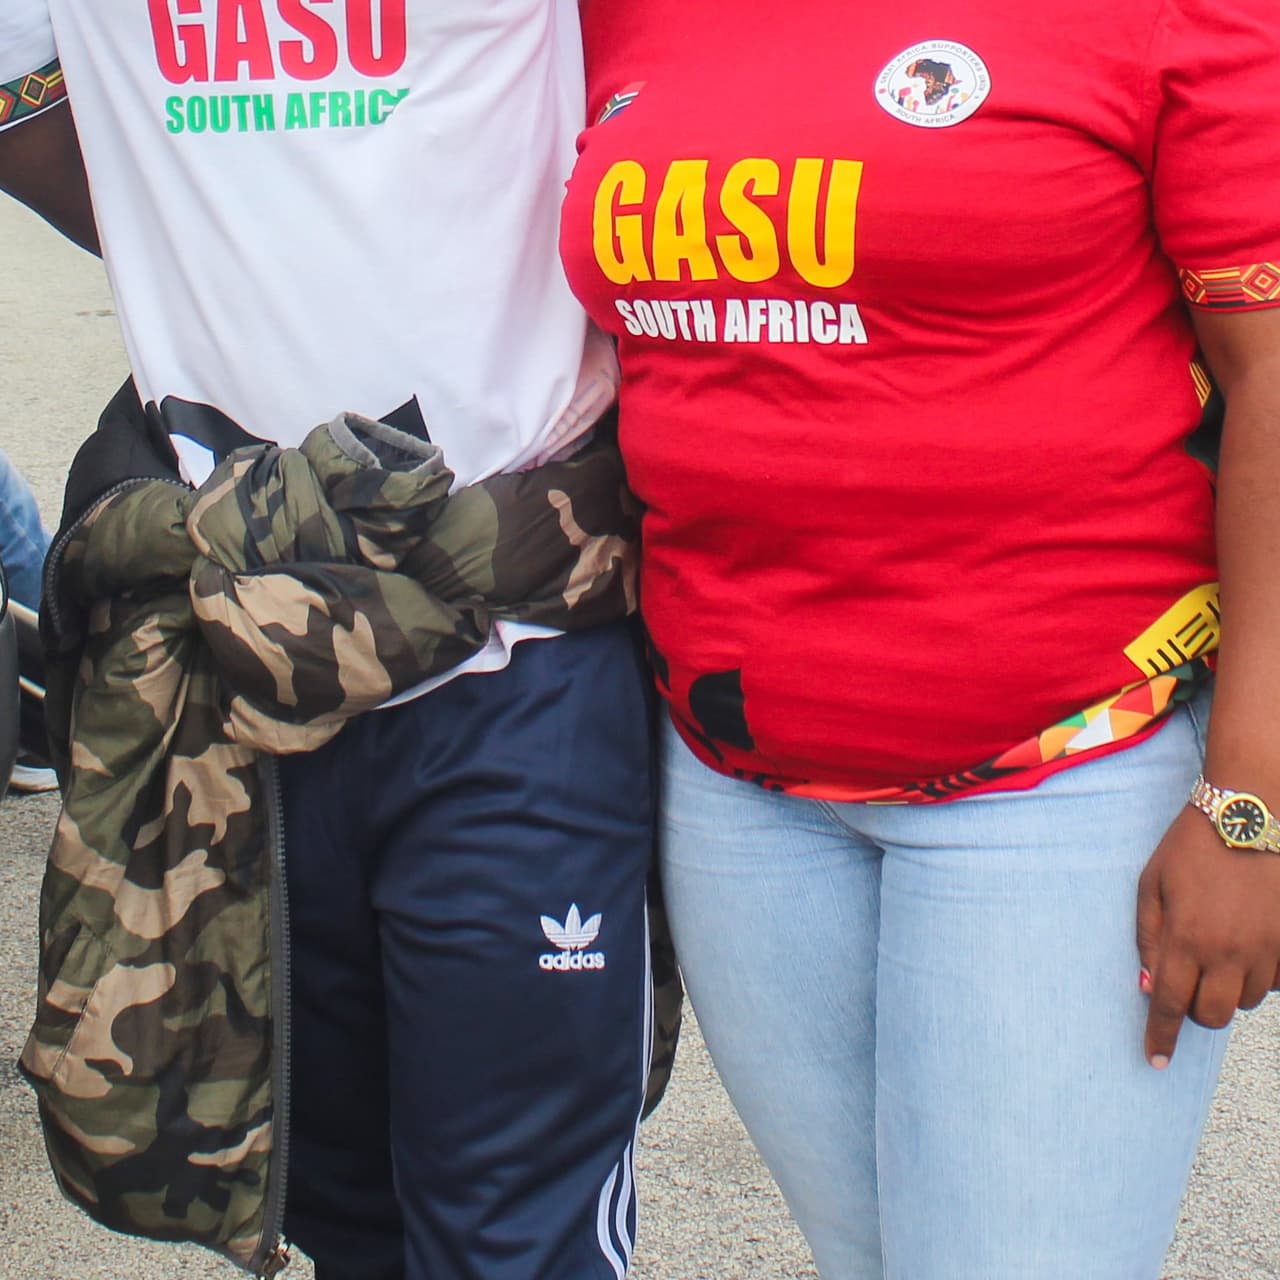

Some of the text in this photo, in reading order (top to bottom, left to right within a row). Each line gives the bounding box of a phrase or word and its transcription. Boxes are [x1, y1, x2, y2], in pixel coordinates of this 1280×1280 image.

[165, 88, 410, 134] SOUTH AFRIC
[592, 158, 864, 288] GASU
[614, 299, 868, 344] SOUTH AFRICA
[538, 949, 605, 970] adidas
